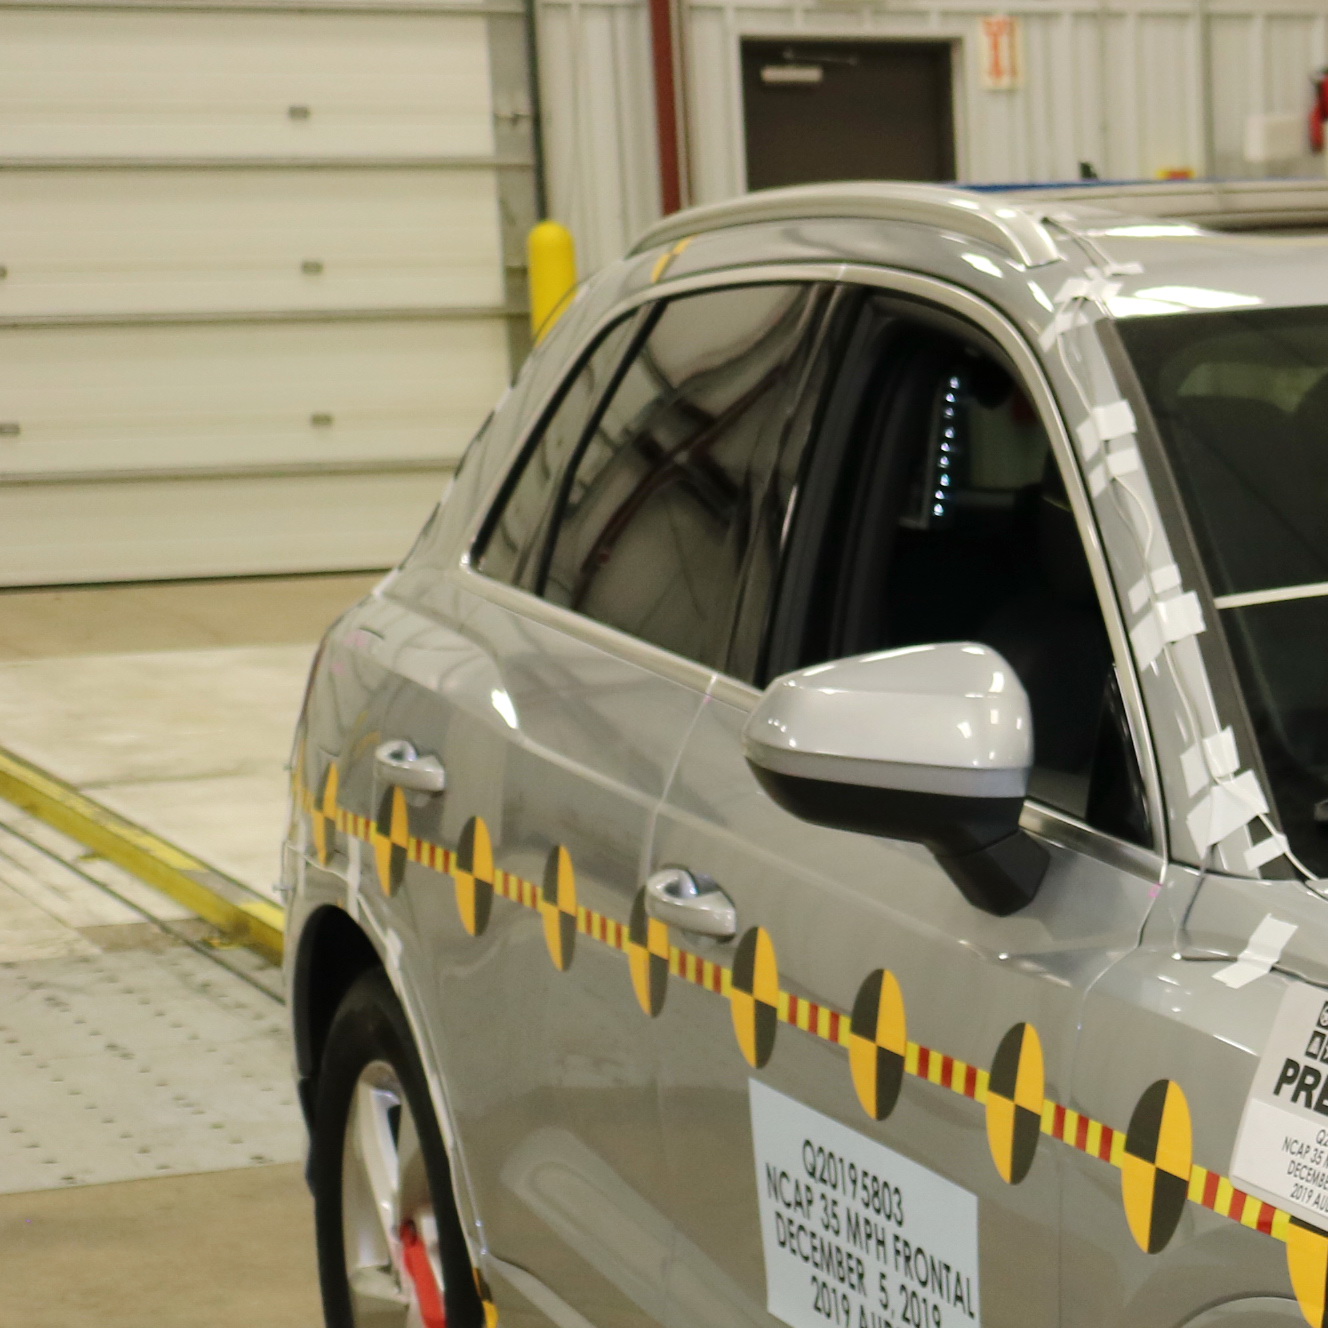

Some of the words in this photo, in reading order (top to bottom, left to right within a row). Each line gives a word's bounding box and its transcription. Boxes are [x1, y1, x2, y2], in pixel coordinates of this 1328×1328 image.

[802, 1139, 904, 1228] Q20195803
[1282, 1136, 1311, 1159] NCAP
[1310, 1148, 1324, 1165] 35
[1290, 1182, 1314, 1203] 2019
[765, 1162, 814, 1220] NCAP
[820, 1193, 840, 1237] 35
[847, 1208, 888, 1265] MPH
[892, 1234, 975, 1320] FRONTAL
[775, 1211, 867, 1297] DECEMBER
